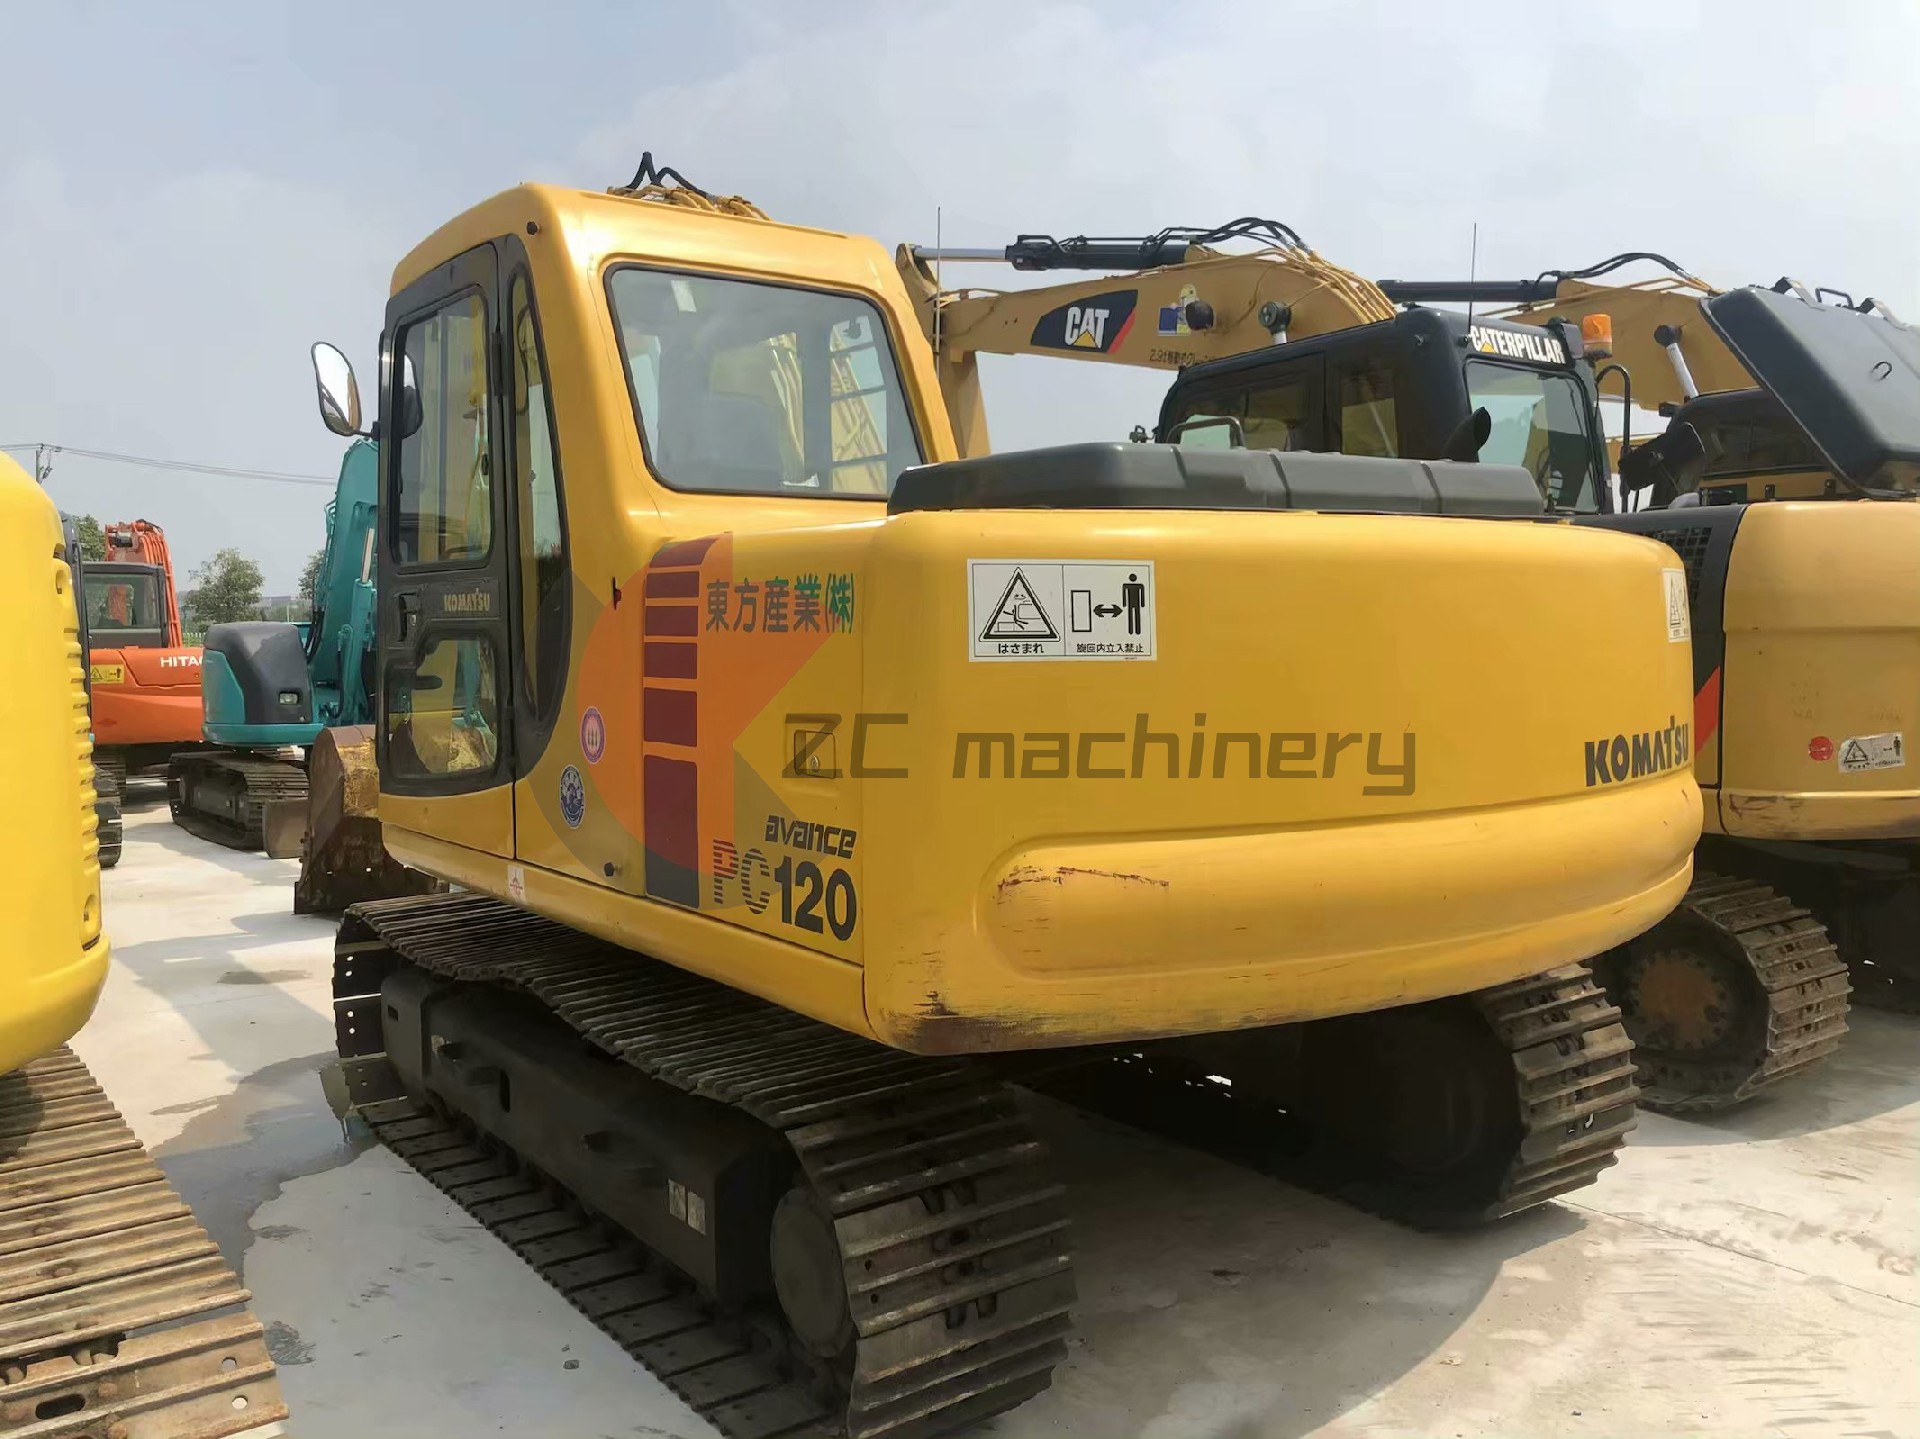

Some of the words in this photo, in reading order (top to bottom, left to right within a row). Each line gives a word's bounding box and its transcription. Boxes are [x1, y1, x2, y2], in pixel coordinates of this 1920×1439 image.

[1065, 306, 1110, 349] CAT
[1468, 325, 1566, 365] CATERPILLAR
[444, 587, 490, 612] KOMATSU
[705, 572, 854, 634] 東方産業(株)
[997, 643, 1045, 654] はさまれ
[1584, 715, 1688, 787] KOMATSU
[765, 815, 857, 859] avance
[713, 839, 857, 941] PC120
